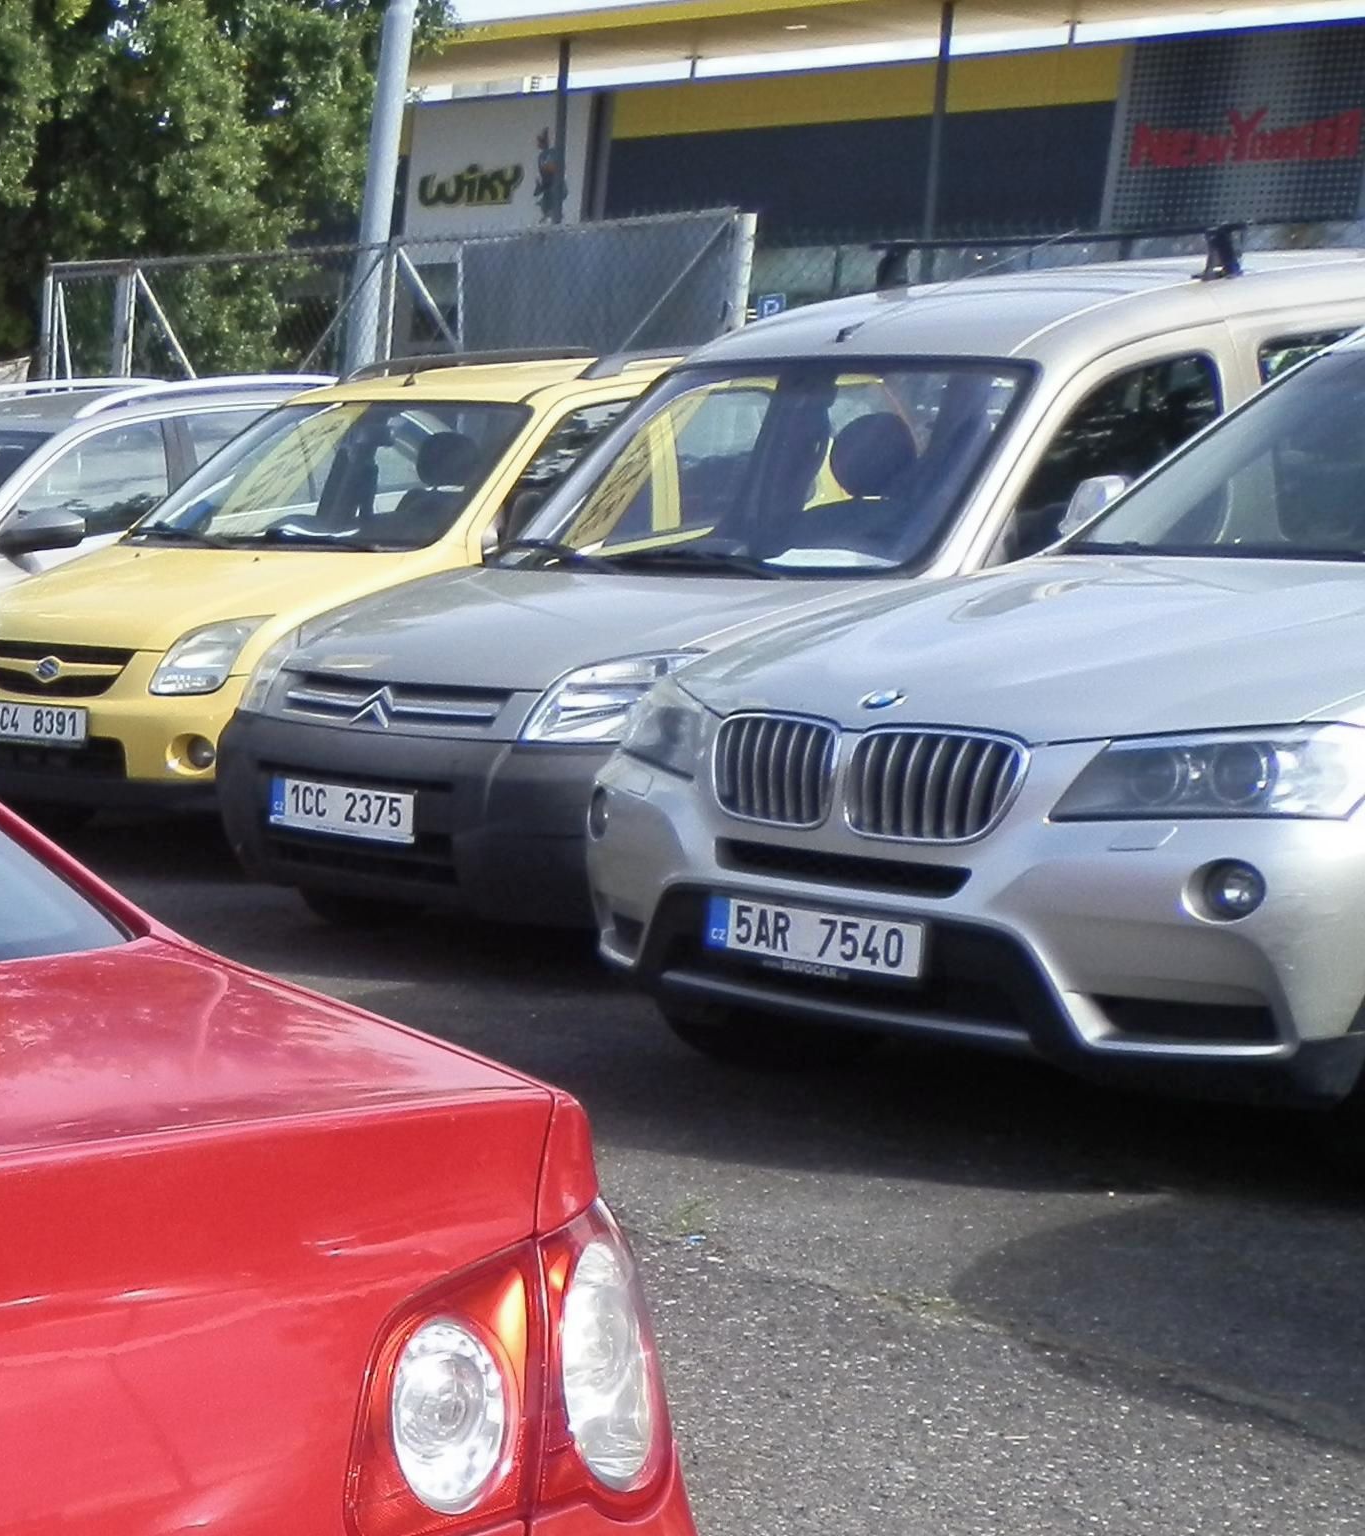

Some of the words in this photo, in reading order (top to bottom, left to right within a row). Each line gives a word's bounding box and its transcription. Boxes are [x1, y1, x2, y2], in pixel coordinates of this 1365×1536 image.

[33, 709, 77, 737] 8391
[291, 784, 327, 818] 1CC
[344, 792, 402, 828] 2375
[711, 928, 727, 941] CZ
[735, 905, 791, 952] 5AR
[817, 918, 904, 968] 7540
